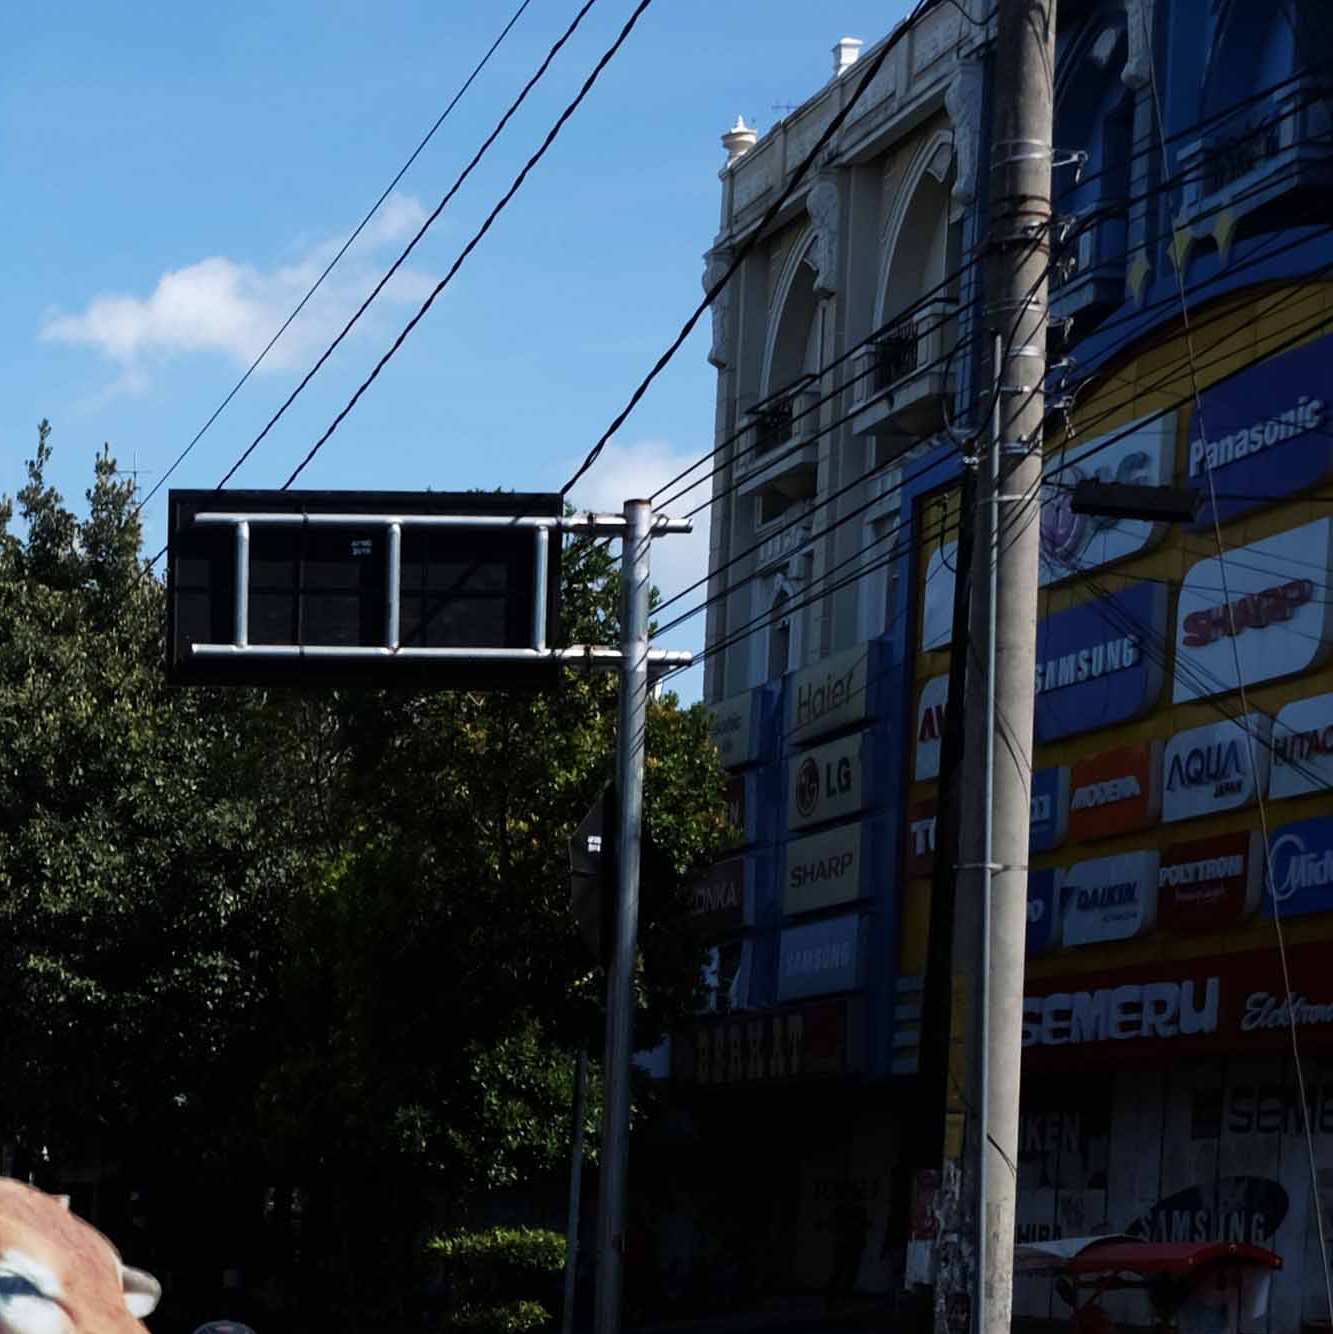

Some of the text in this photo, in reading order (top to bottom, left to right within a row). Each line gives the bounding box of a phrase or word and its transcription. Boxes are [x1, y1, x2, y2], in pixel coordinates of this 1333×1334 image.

[1187, 396, 1325, 479] Panasonic
[796, 667, 854, 722] Haier
[825, 757, 853, 798] LG
[1166, 740, 1241, 791] AQUA
[789, 852, 854, 888] SHARP
[1157, 853, 1245, 888] POLYTRON
[1076, 880, 1138, 909] DAIKIN
[1021, 975, 1221, 1049] SEMERU
